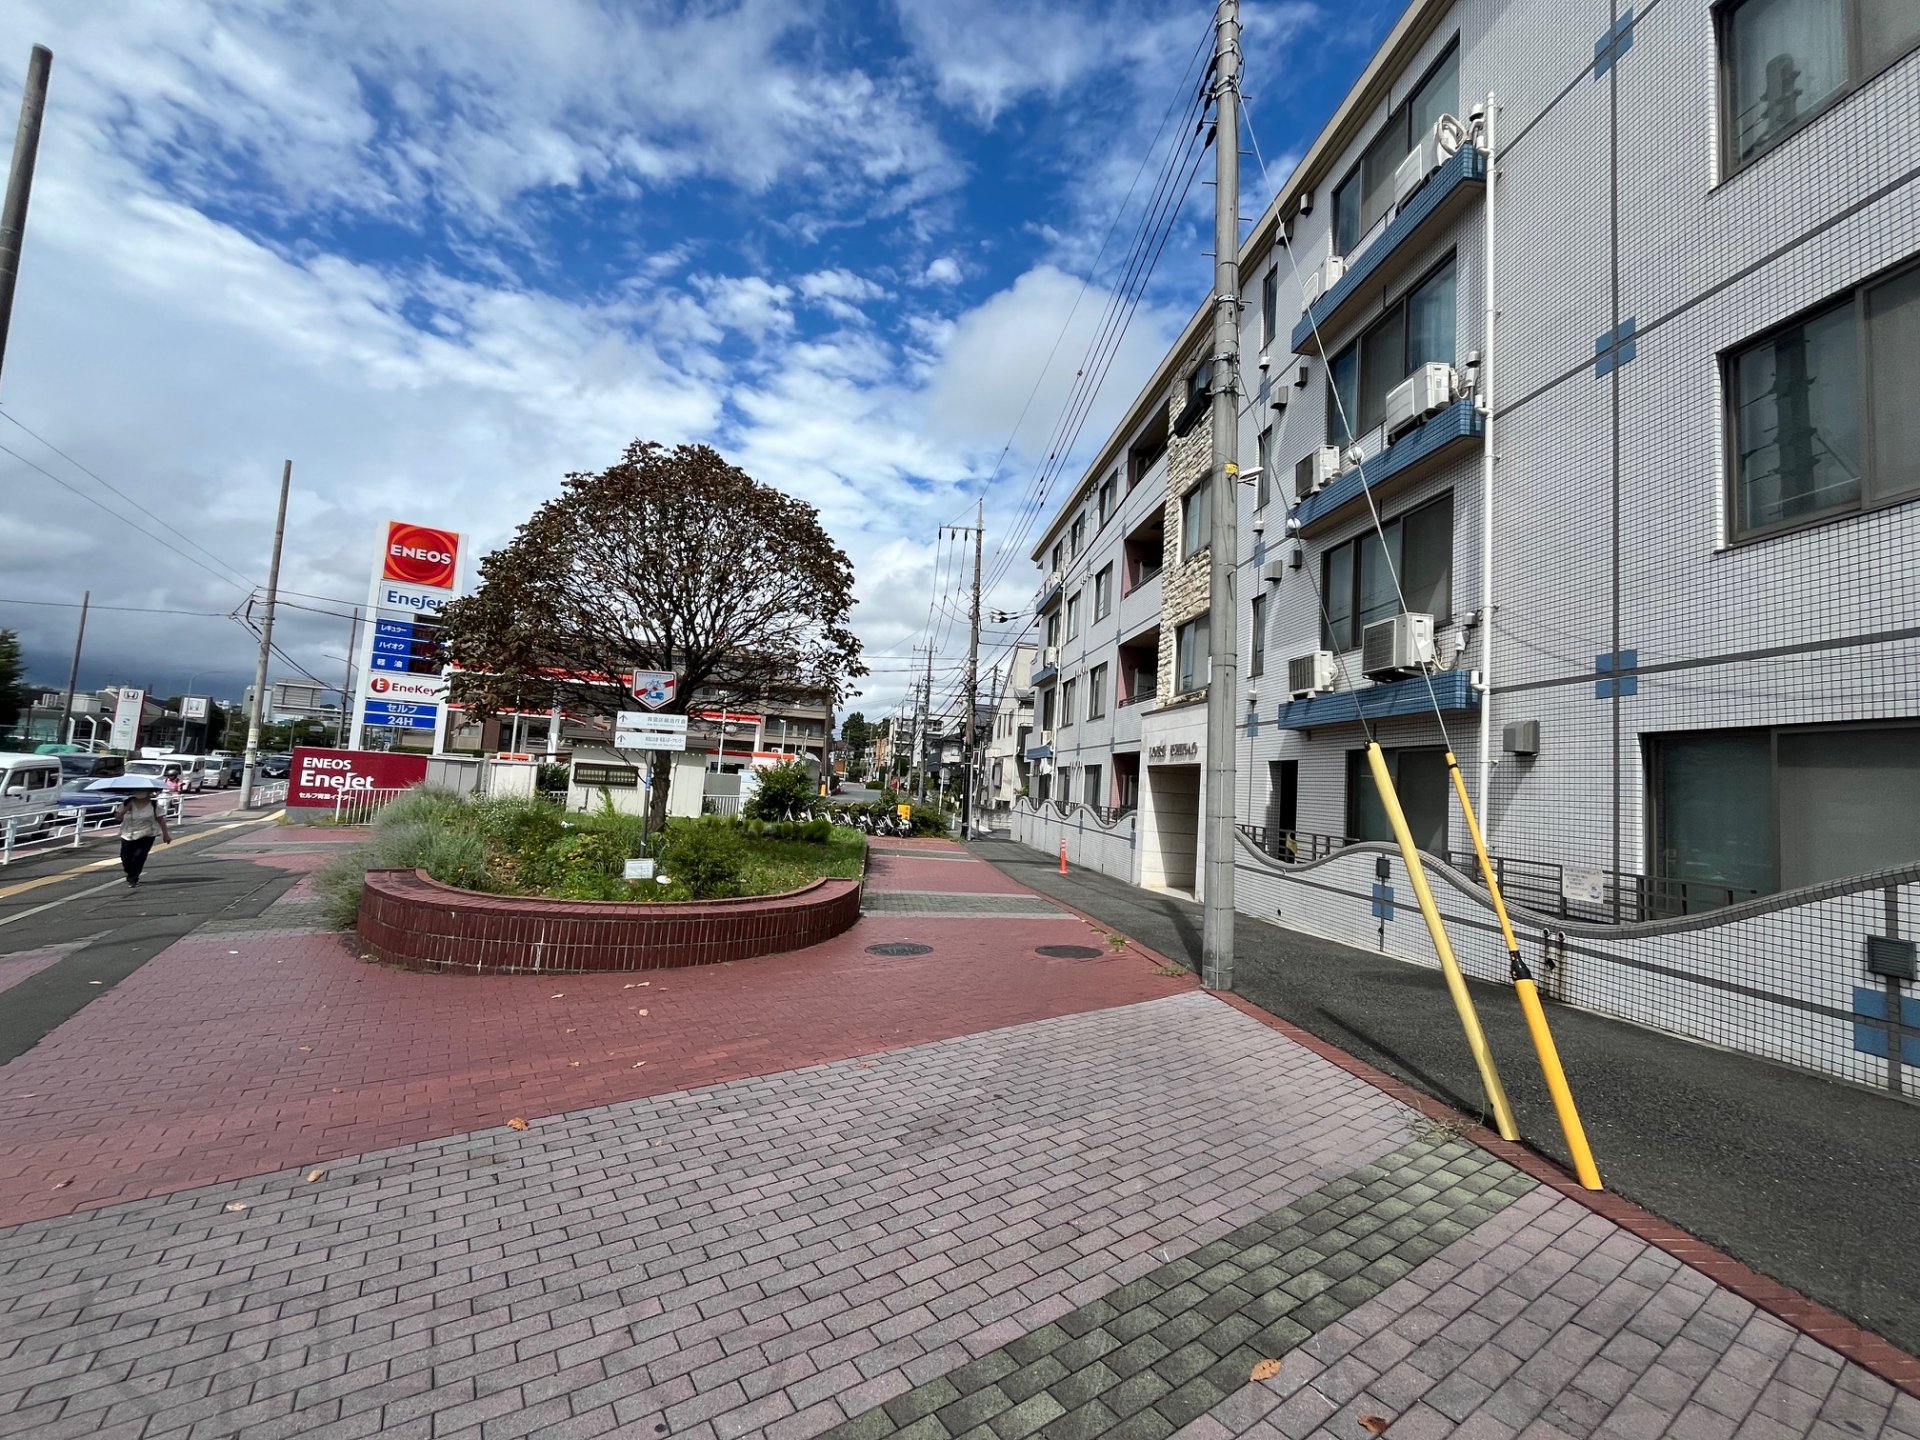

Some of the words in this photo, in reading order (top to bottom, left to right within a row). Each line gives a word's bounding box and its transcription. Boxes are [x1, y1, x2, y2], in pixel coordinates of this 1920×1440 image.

[390, 544, 452, 565] ENEOS
[381, 624, 407, 633] レギュラー
[379, 641, 405, 651] ハイオク
[391, 683, 437, 697] EneKey
[386, 703, 418, 714] セルフ
[387, 716, 414, 726] 24H
[303, 757, 352, 770] ENEOS
